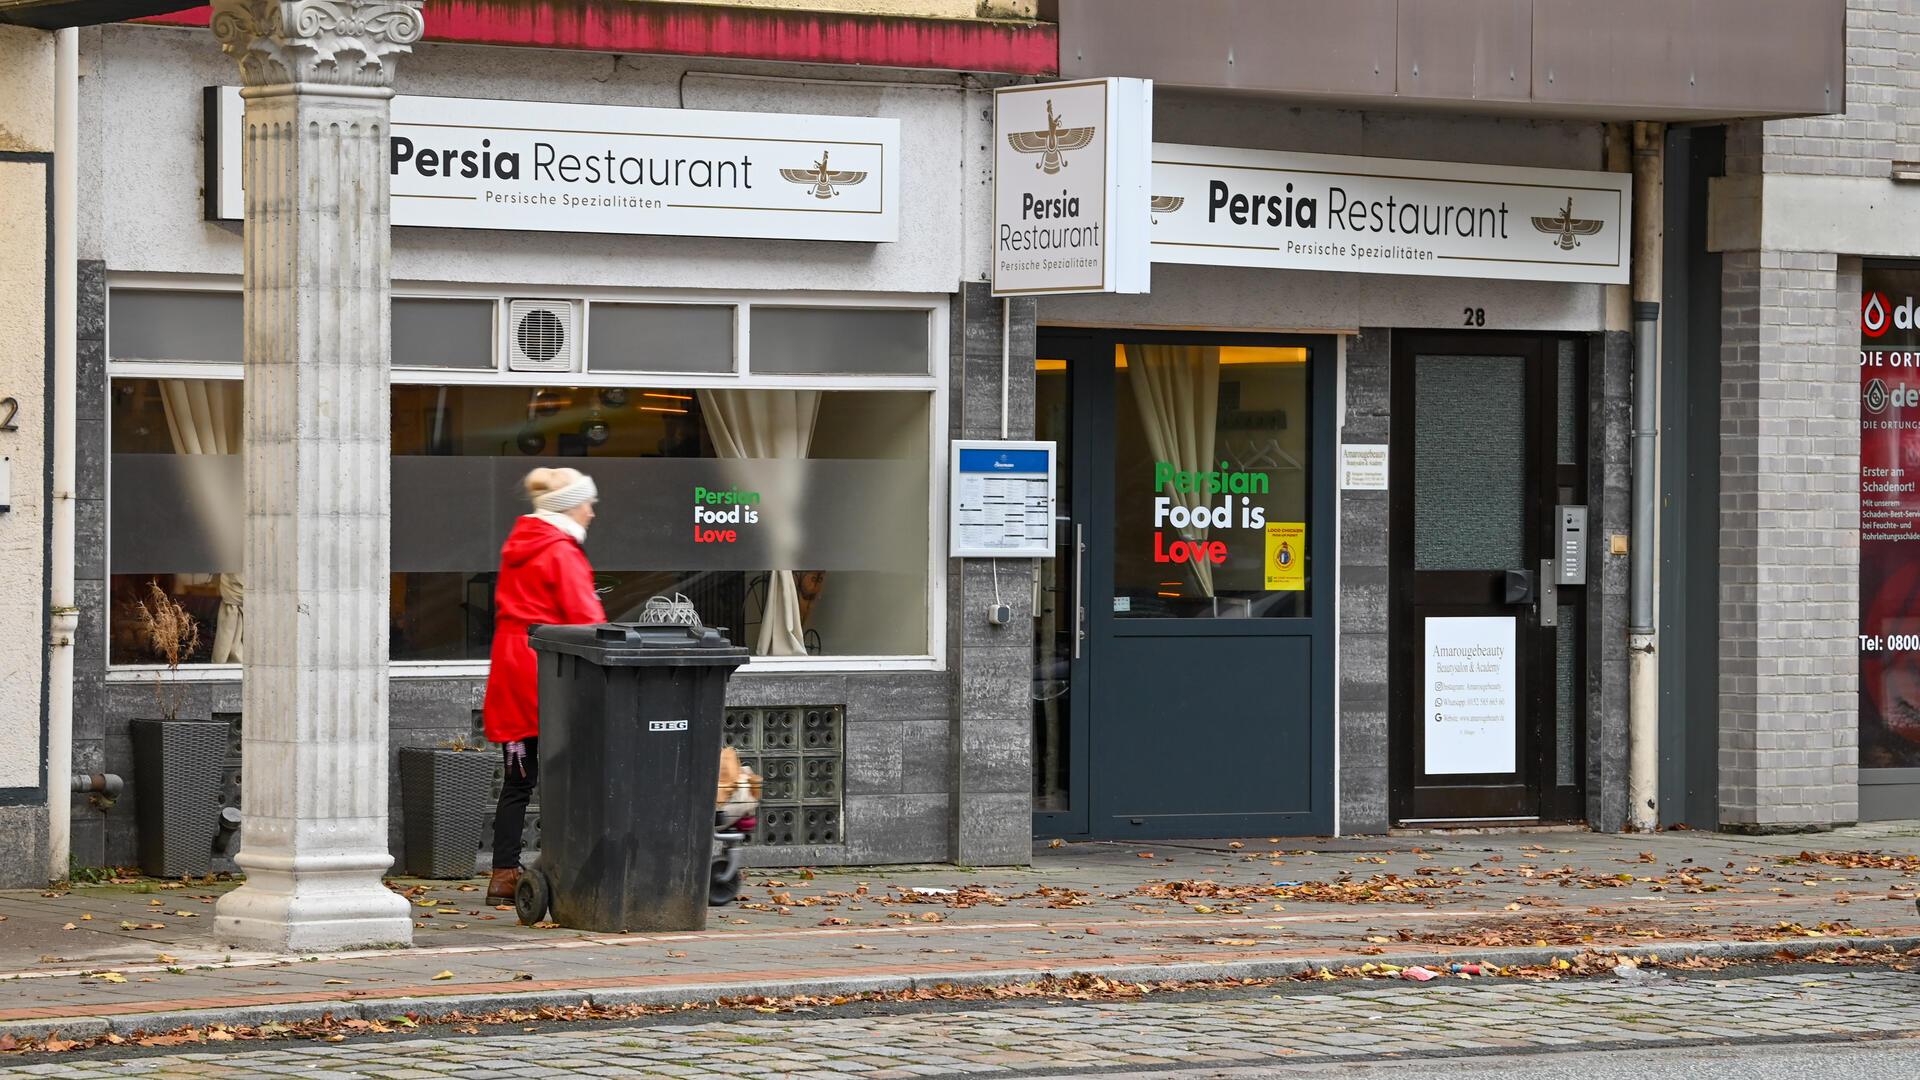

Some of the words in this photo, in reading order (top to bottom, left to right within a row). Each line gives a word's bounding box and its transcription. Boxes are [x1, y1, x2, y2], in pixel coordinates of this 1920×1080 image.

[391, 136, 520, 180] Persia
[534, 142, 752, 189] Restaurant
[486, 191, 556, 205] Persische
[562, 193, 662, 209] Spezialitäten
[1023, 189, 1079, 220] Persia
[1208, 180, 1317, 228] Persia
[1328, 187, 1509, 239] Restaurant
[1000, 221, 1099, 251] Restaurant
[1287, 240, 1346, 256] Persische
[1351, 243, 1433, 261] Spezialitäten
[1000, 260, 1040, 271] Persische
[1043, 258, 1098, 271] Spezialitäten
[1463, 308, 1486, 326] 28
[1860, 351, 1883, 367] DIE
[1890, 382, 1920, 408] de
[1863, 421, 1877, 429] DIE
[1155, 461, 1269, 494] Persian
[1862, 467, 1889, 477] Erster
[1891, 468, 1904, 477] am
[695, 485, 760, 504] Persian
[1862, 481, 1915, 492] Schadenort!
[694, 505, 740, 523] Food
[744, 505, 759, 523] is
[1154, 495, 1232, 529] Food
[1242, 496, 1265, 529] is
[694, 525, 737, 543] Love
[1862, 521, 1872, 529] bei
[1900, 521, 1911, 529] und
[1154, 532, 1228, 564] Love
[1859, 635, 1883, 651] Tel:
[1887, 634, 1920, 651] 0800
[1433, 644, 1505, 660] Amarougebeauty
[1469, 662, 1475, 673] &
[650, 721, 687, 730] BEG
